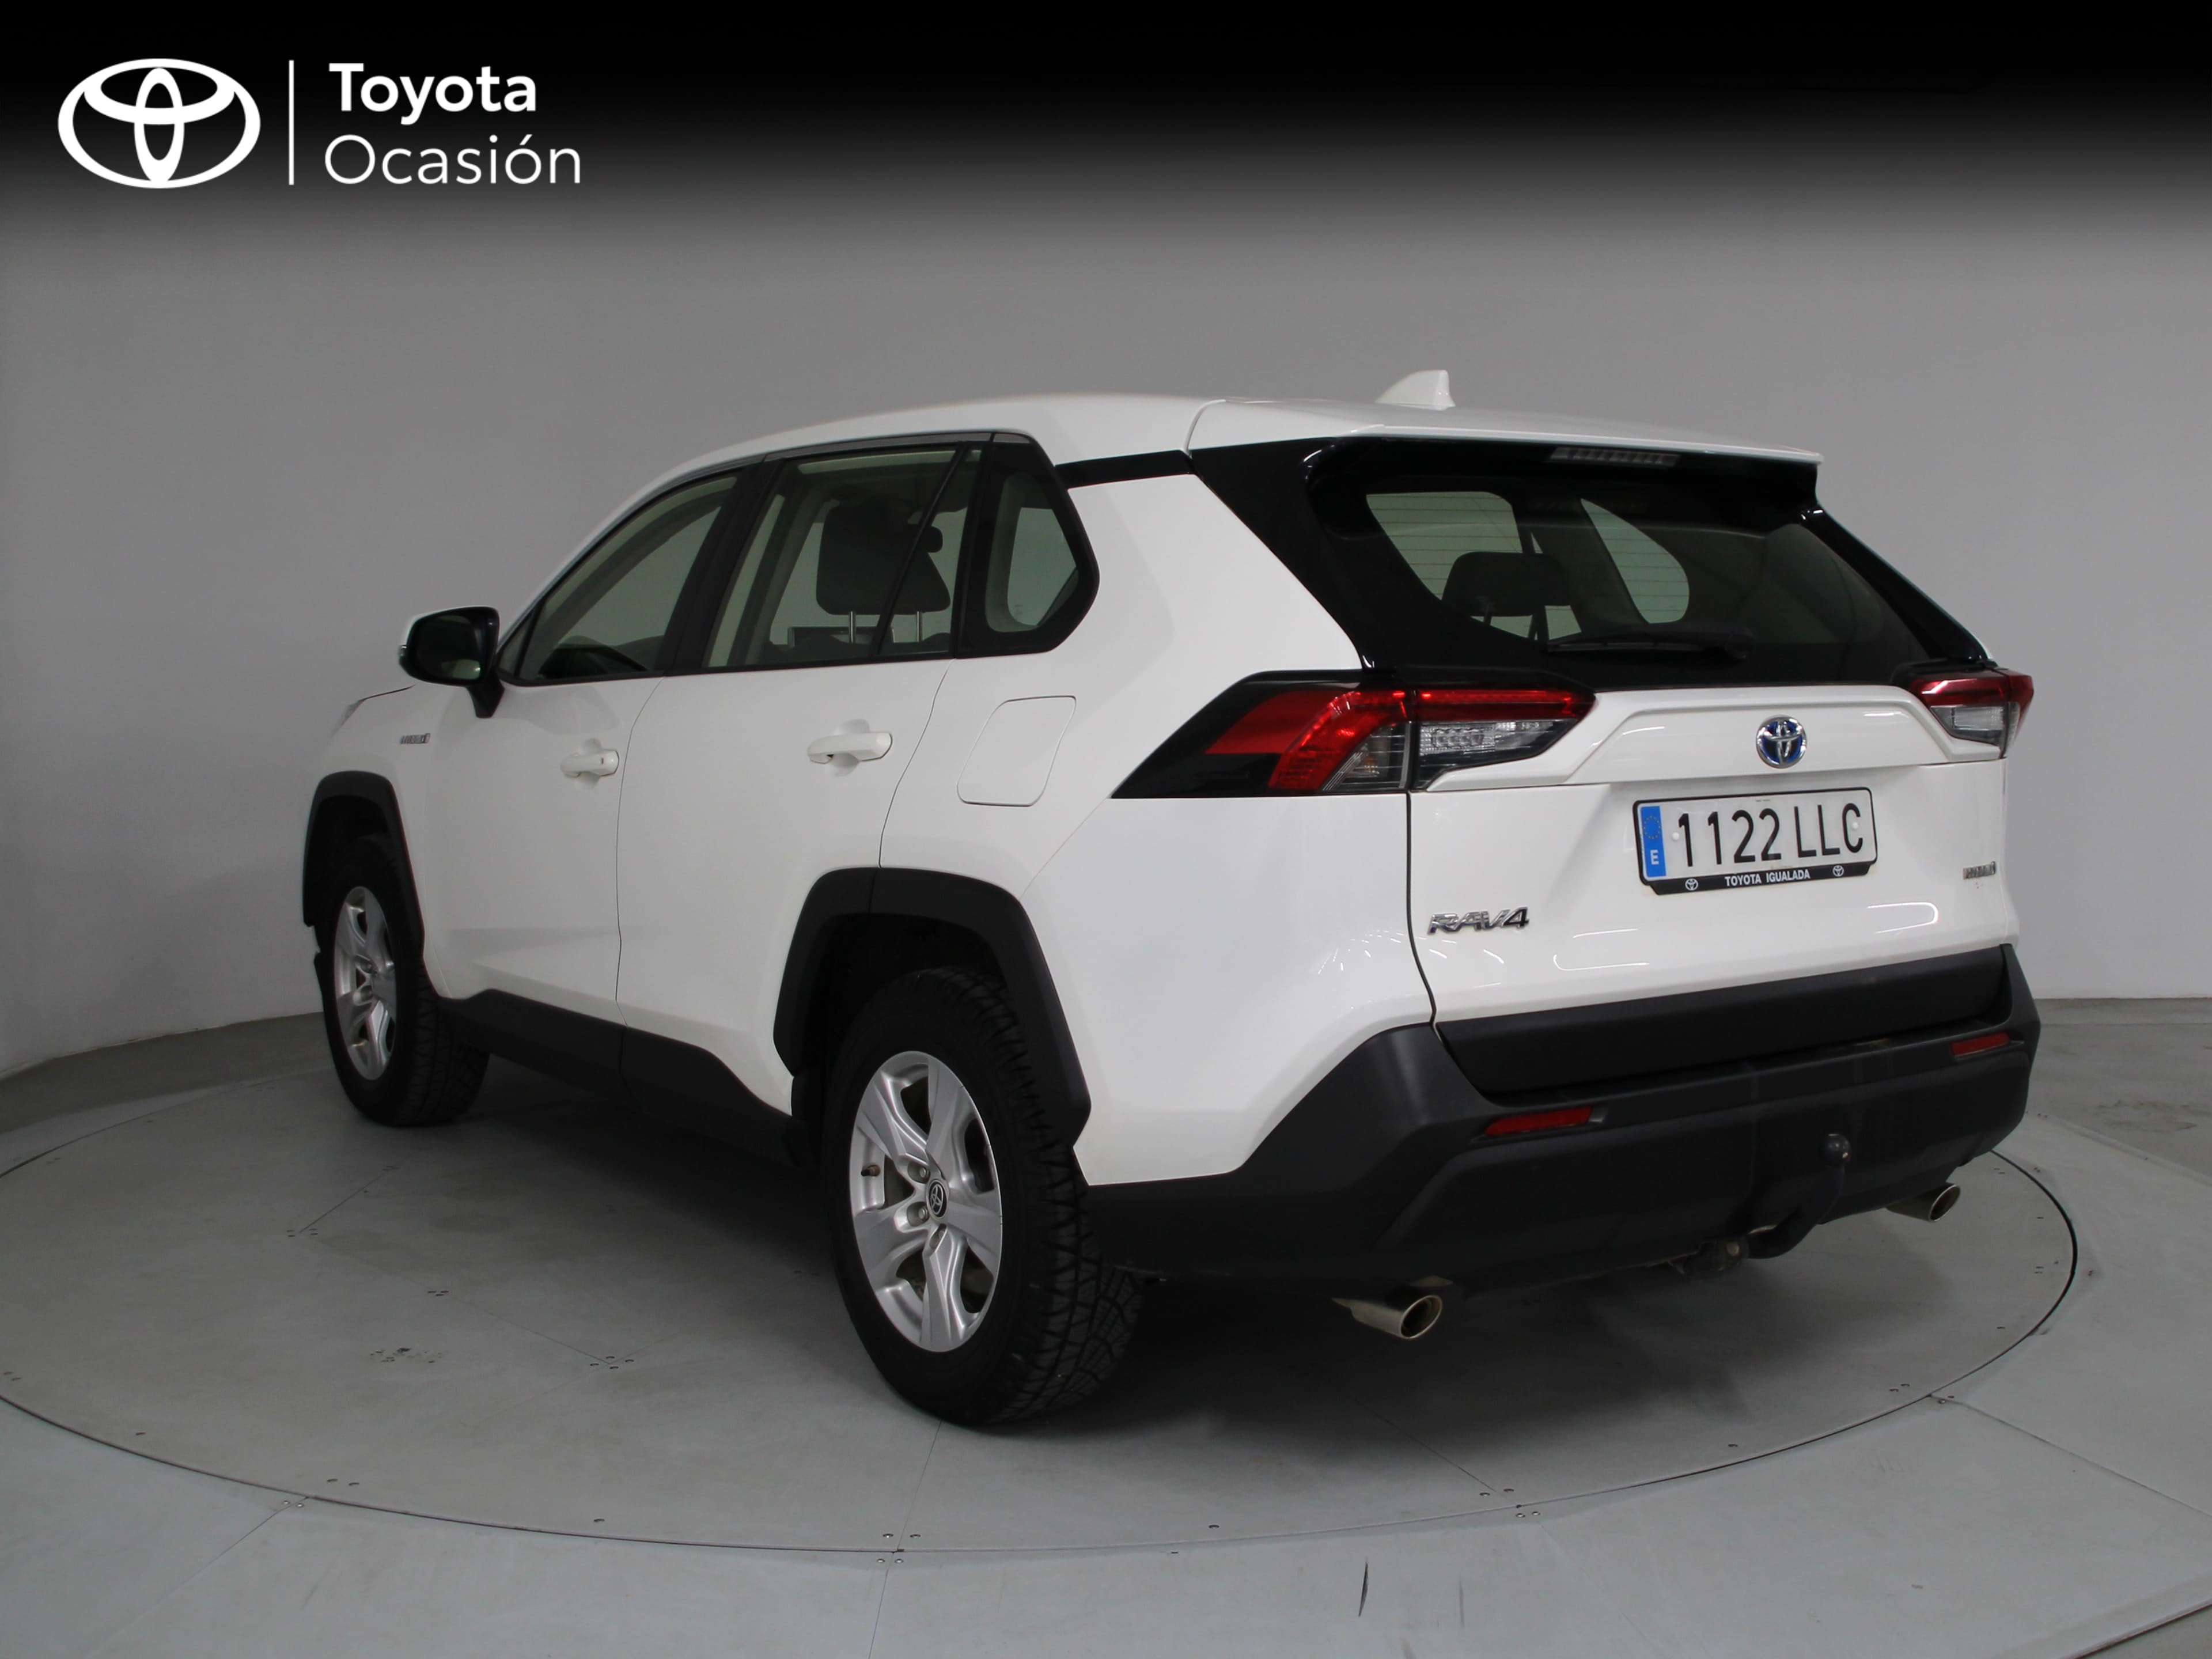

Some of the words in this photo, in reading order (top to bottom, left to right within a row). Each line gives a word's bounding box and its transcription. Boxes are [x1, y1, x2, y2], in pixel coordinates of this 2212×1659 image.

[1678, 807, 1782, 867] 1122
[1794, 802, 1863, 858] LLC
[1650, 849, 1660, 865] E
[1725, 873, 1762, 886] TOYOTA
[1766, 869, 1810, 883] IGUALADA
[1427, 906, 1529, 935] RAV4
